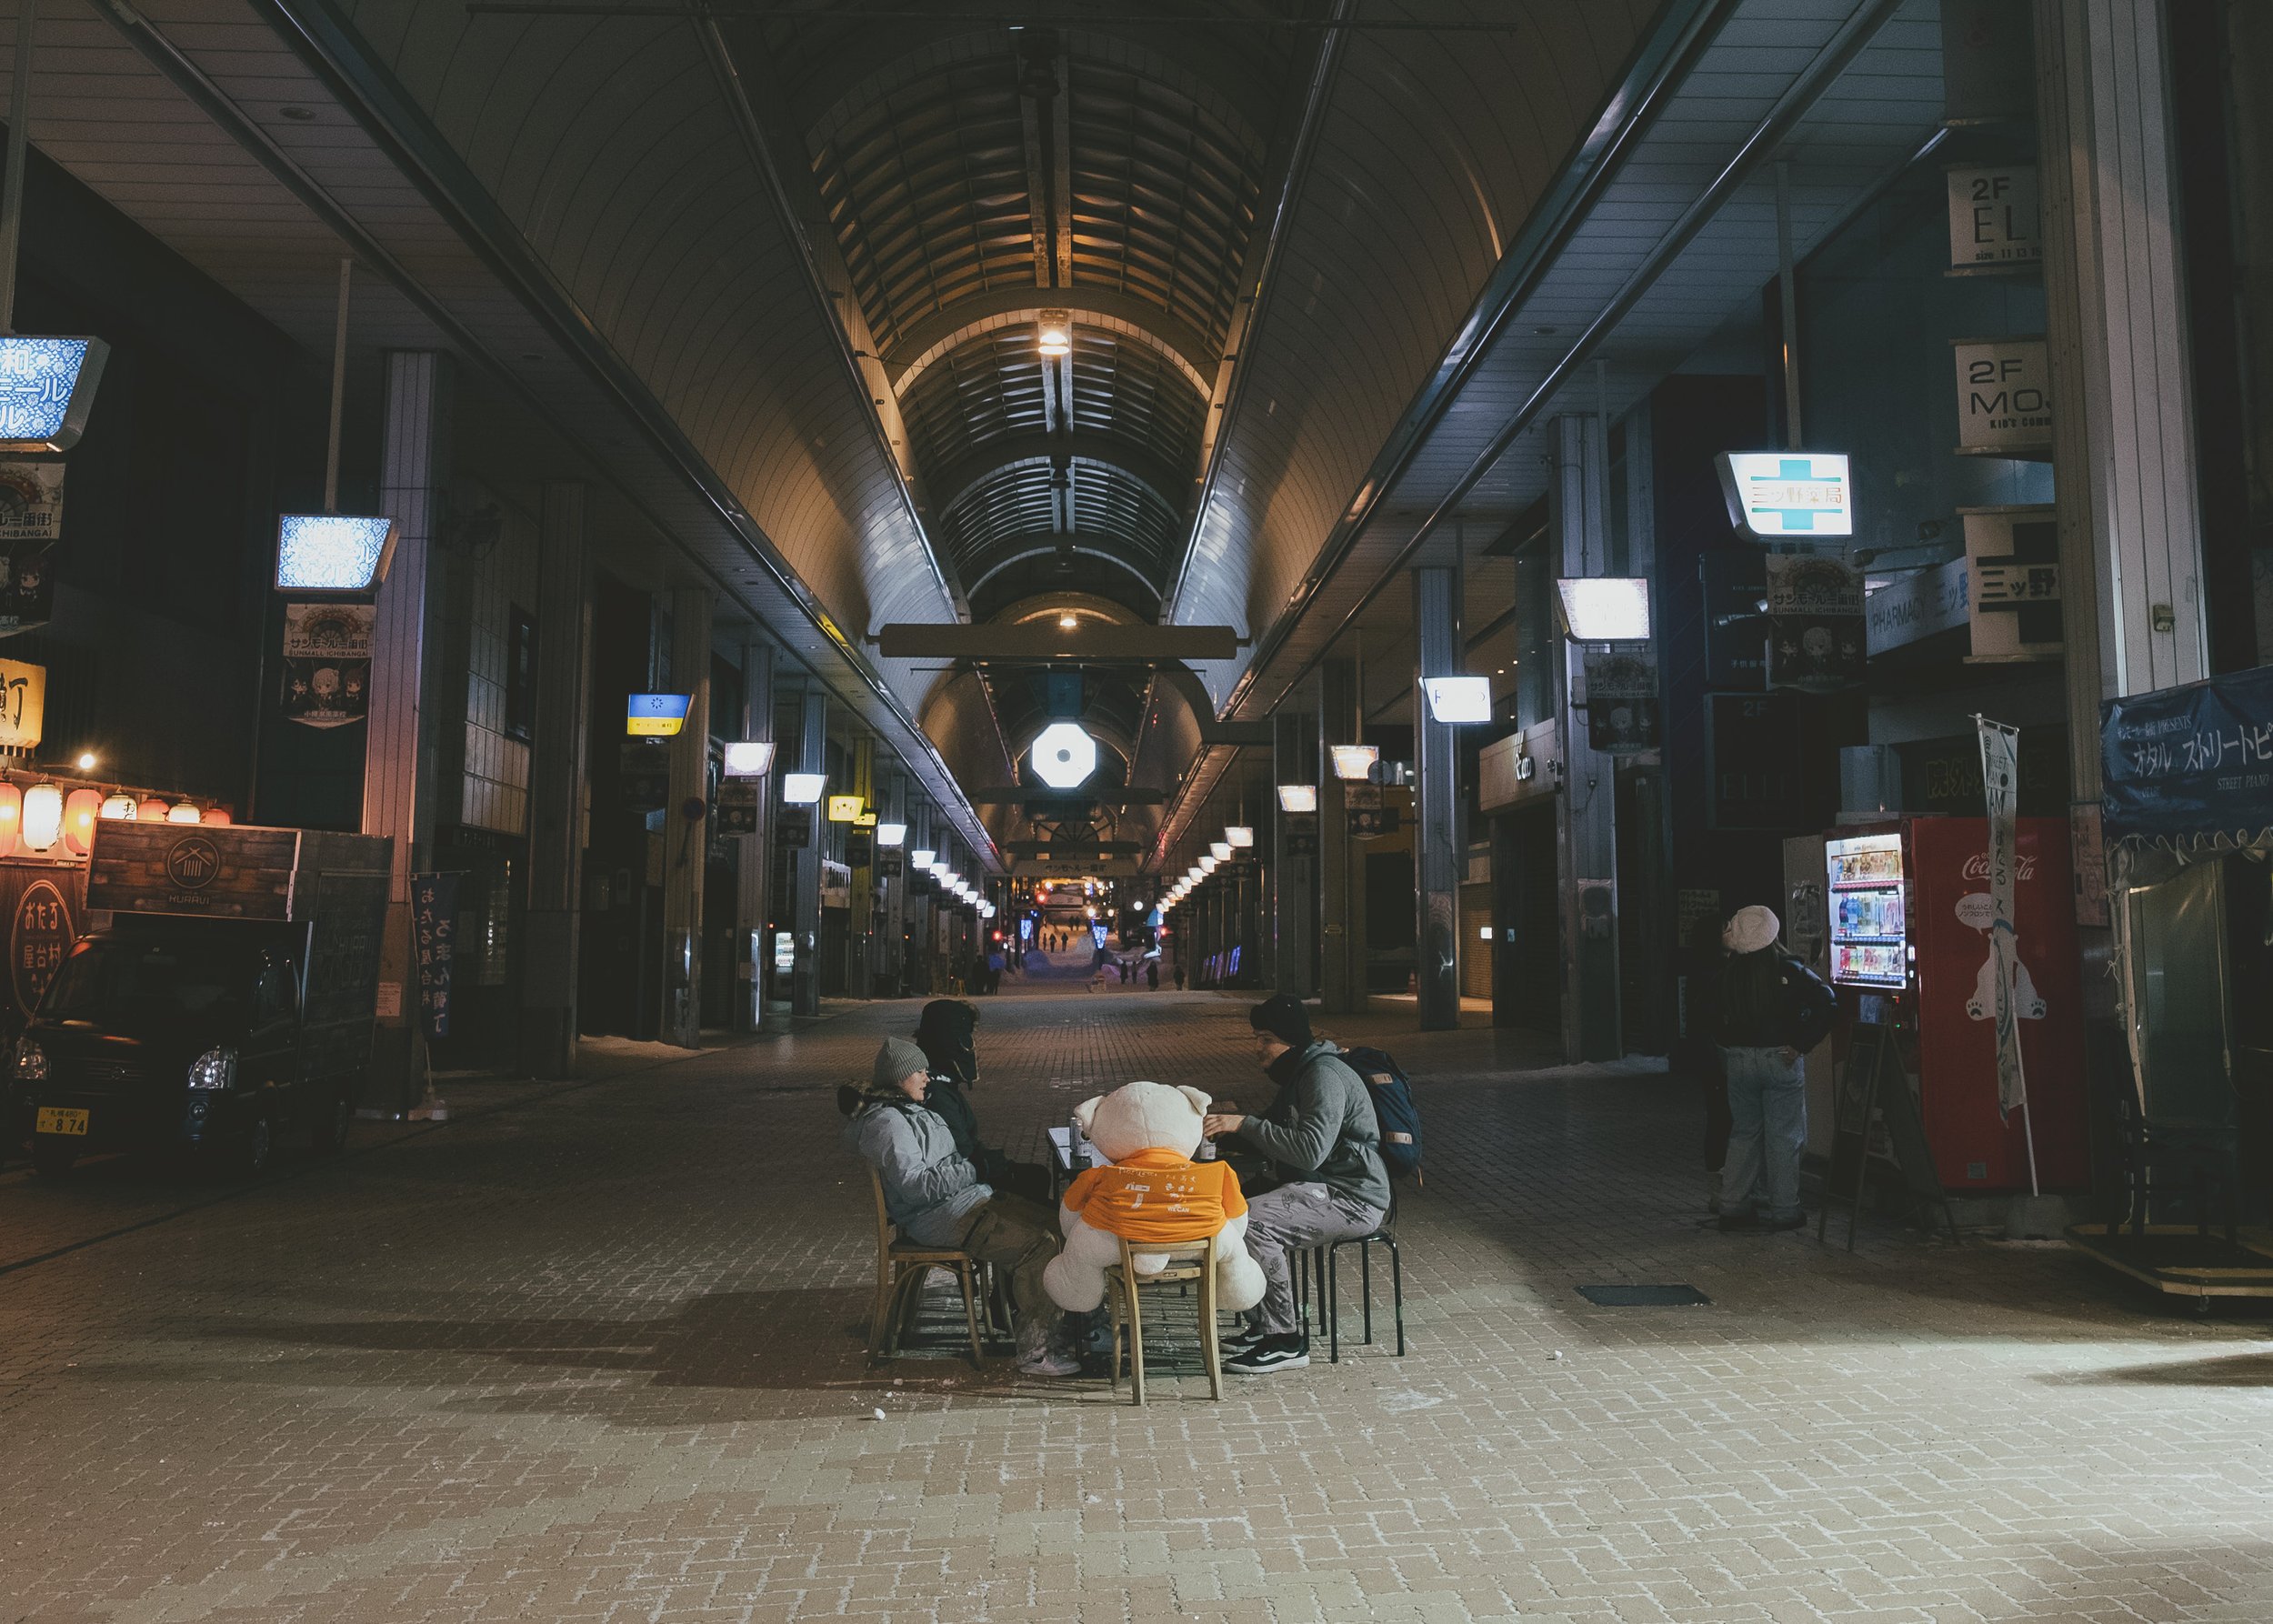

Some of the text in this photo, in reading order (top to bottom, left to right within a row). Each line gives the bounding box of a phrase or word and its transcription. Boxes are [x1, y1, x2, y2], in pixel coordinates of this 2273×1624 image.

[1972, 176, 2010, 201] 2F
[1974, 205, 2041, 244] EL
[1969, 359, 2022, 384] 2F
[1971, 388, 2051, 415] MO
[1872, 595, 1926, 635] PHARMACY
[2158, 715, 2192, 734] PRESENTS
[2134, 742, 2172, 778] オタル
[2217, 774, 2269, 790] STREET PIANO
[25, 902, 58, 930] おたる
[23, 943, 62, 968] 屋台村
